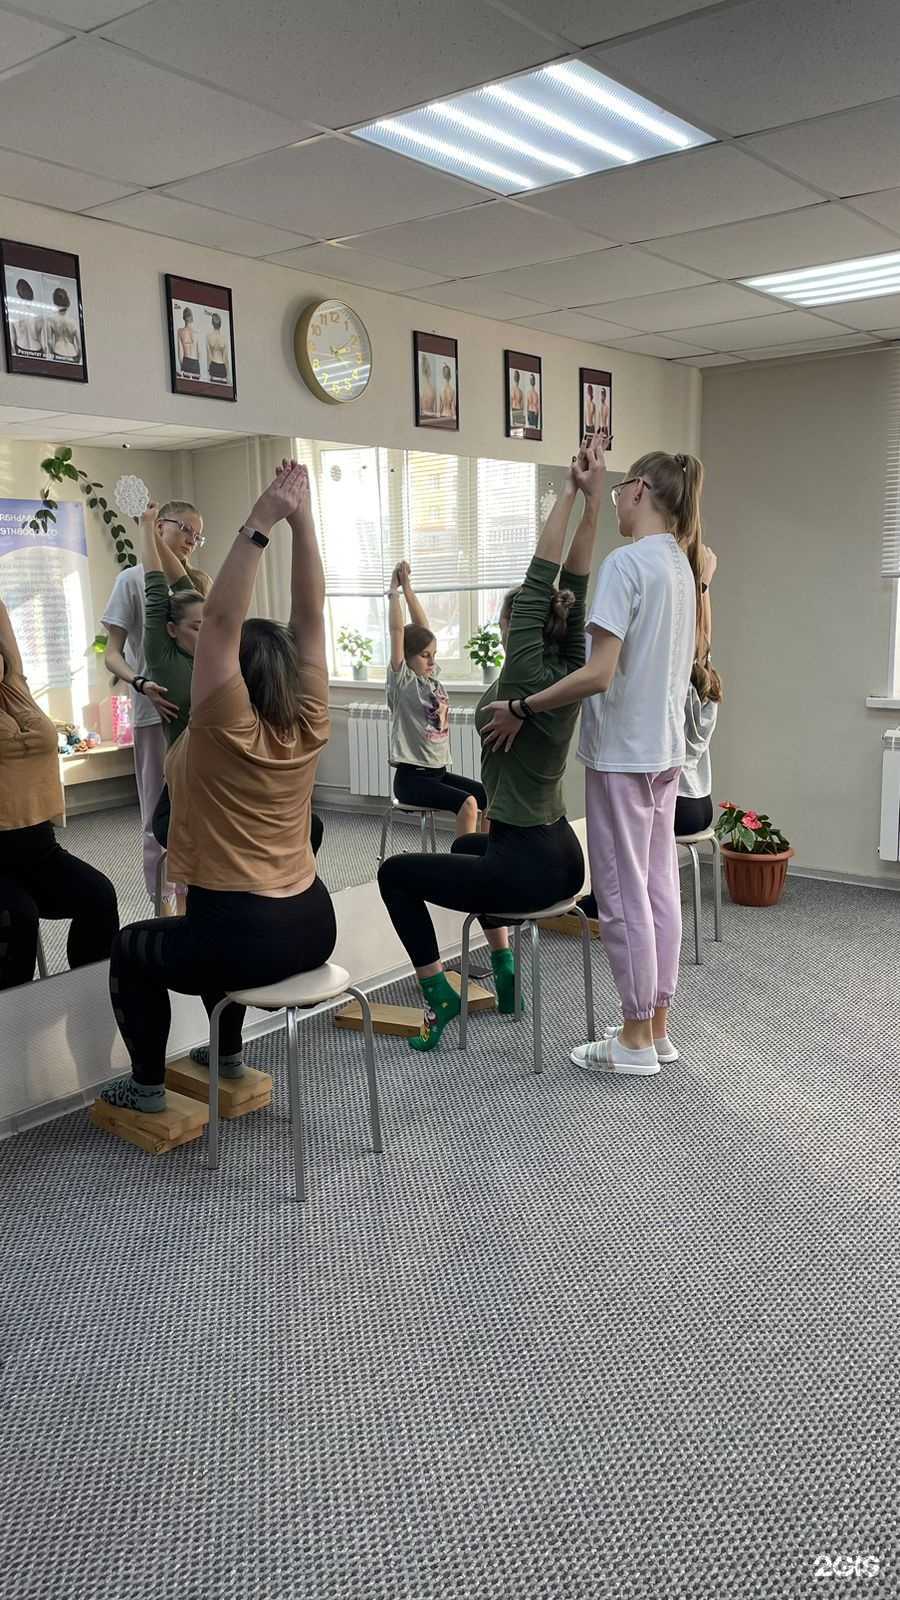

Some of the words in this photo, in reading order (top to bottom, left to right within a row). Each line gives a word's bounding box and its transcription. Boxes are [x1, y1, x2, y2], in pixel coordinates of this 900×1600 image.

[319, 312, 328, 326] 11
[328, 311, 340, 324] 12
[312, 358, 320, 370] 8
[322, 373, 329, 385] 7
[352, 368, 359, 380] 4
